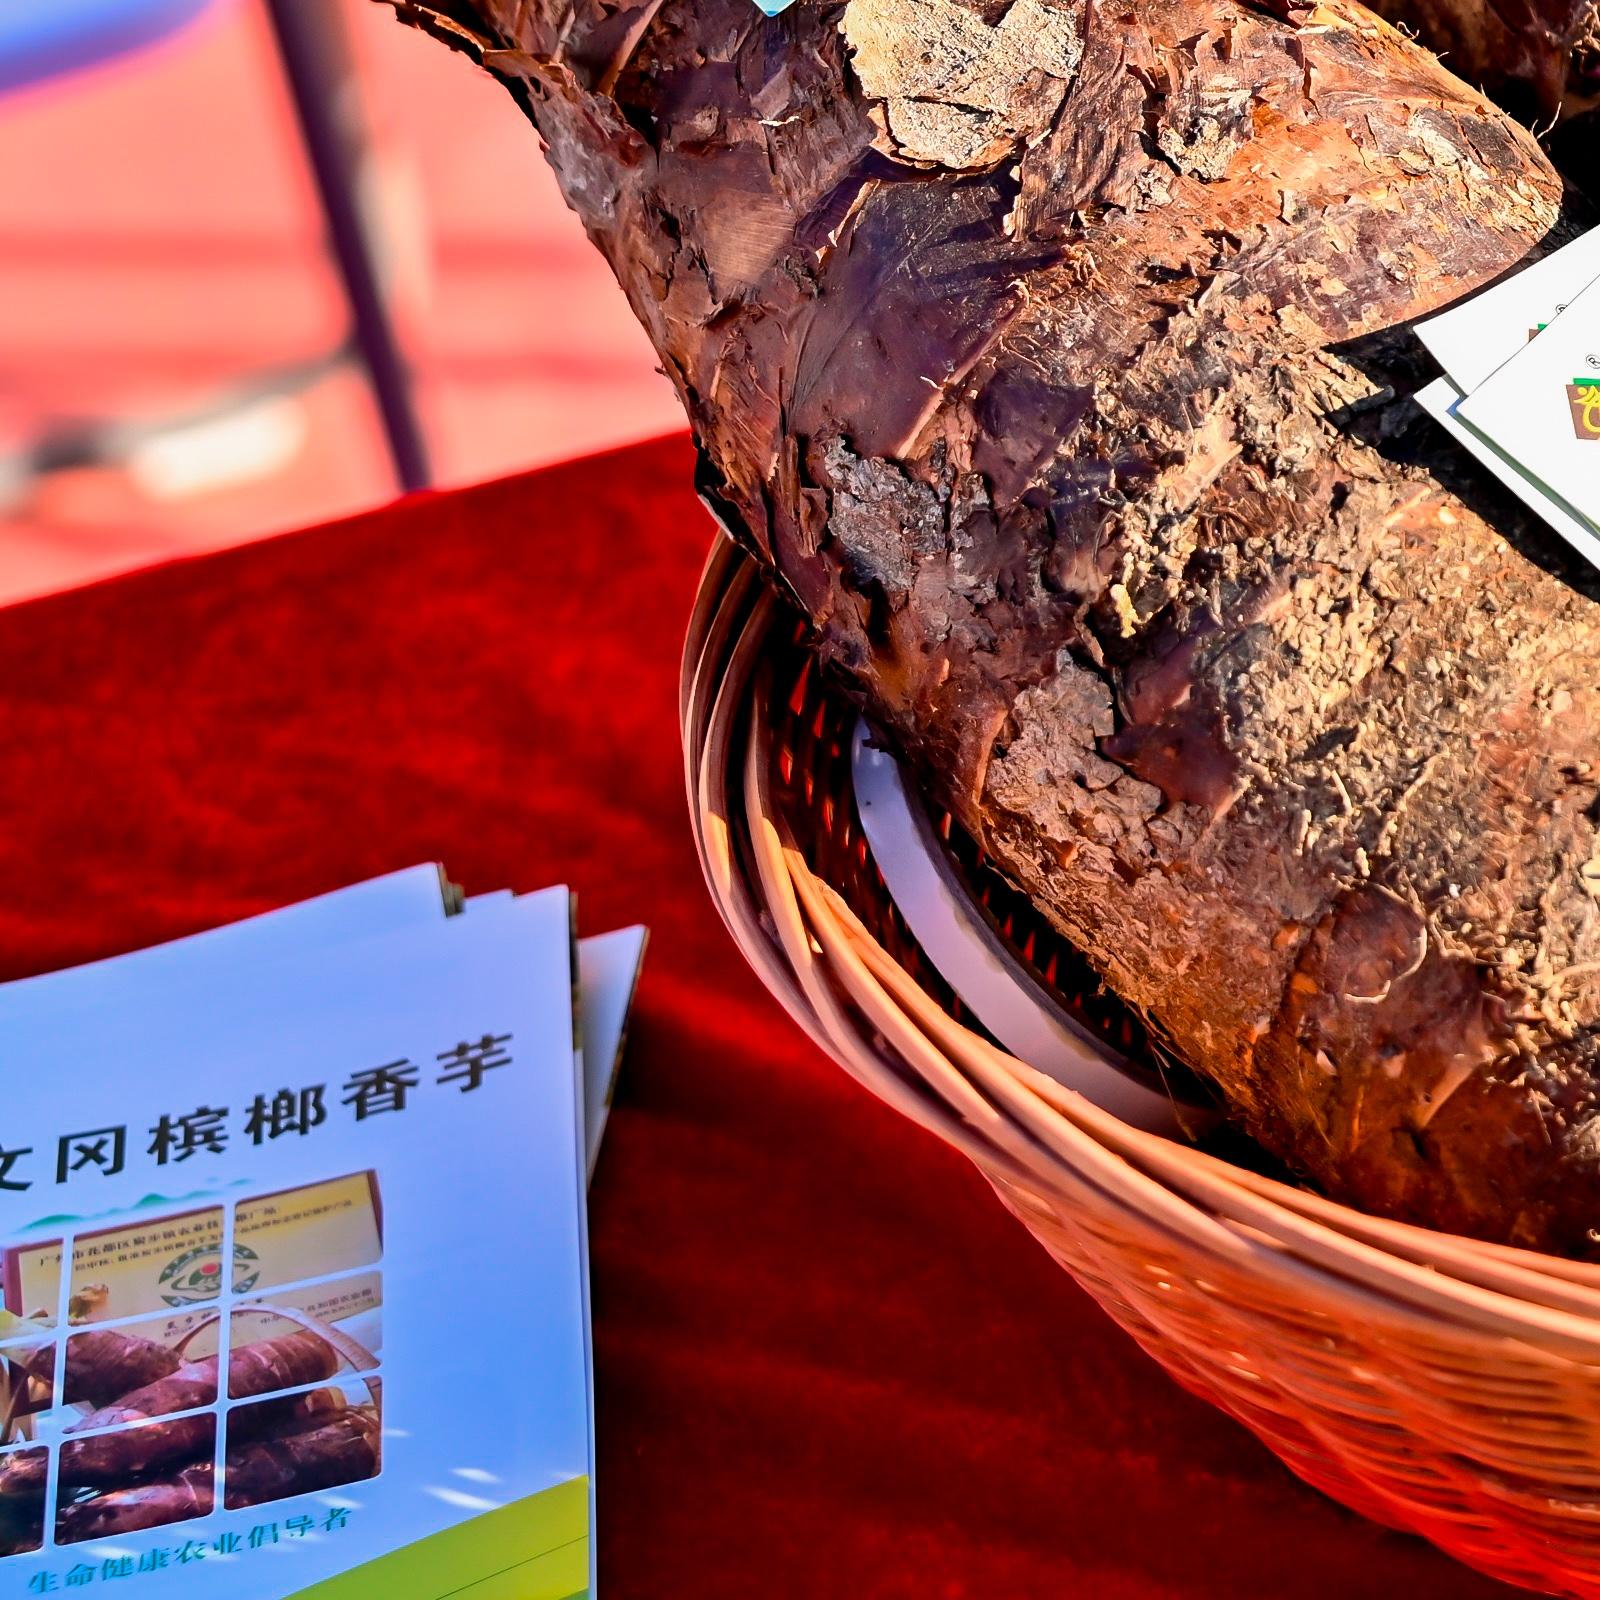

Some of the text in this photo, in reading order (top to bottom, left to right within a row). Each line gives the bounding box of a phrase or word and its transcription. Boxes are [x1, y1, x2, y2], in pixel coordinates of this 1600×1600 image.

[28, 1506, 353, 1594] 生命健康农业倡导者
